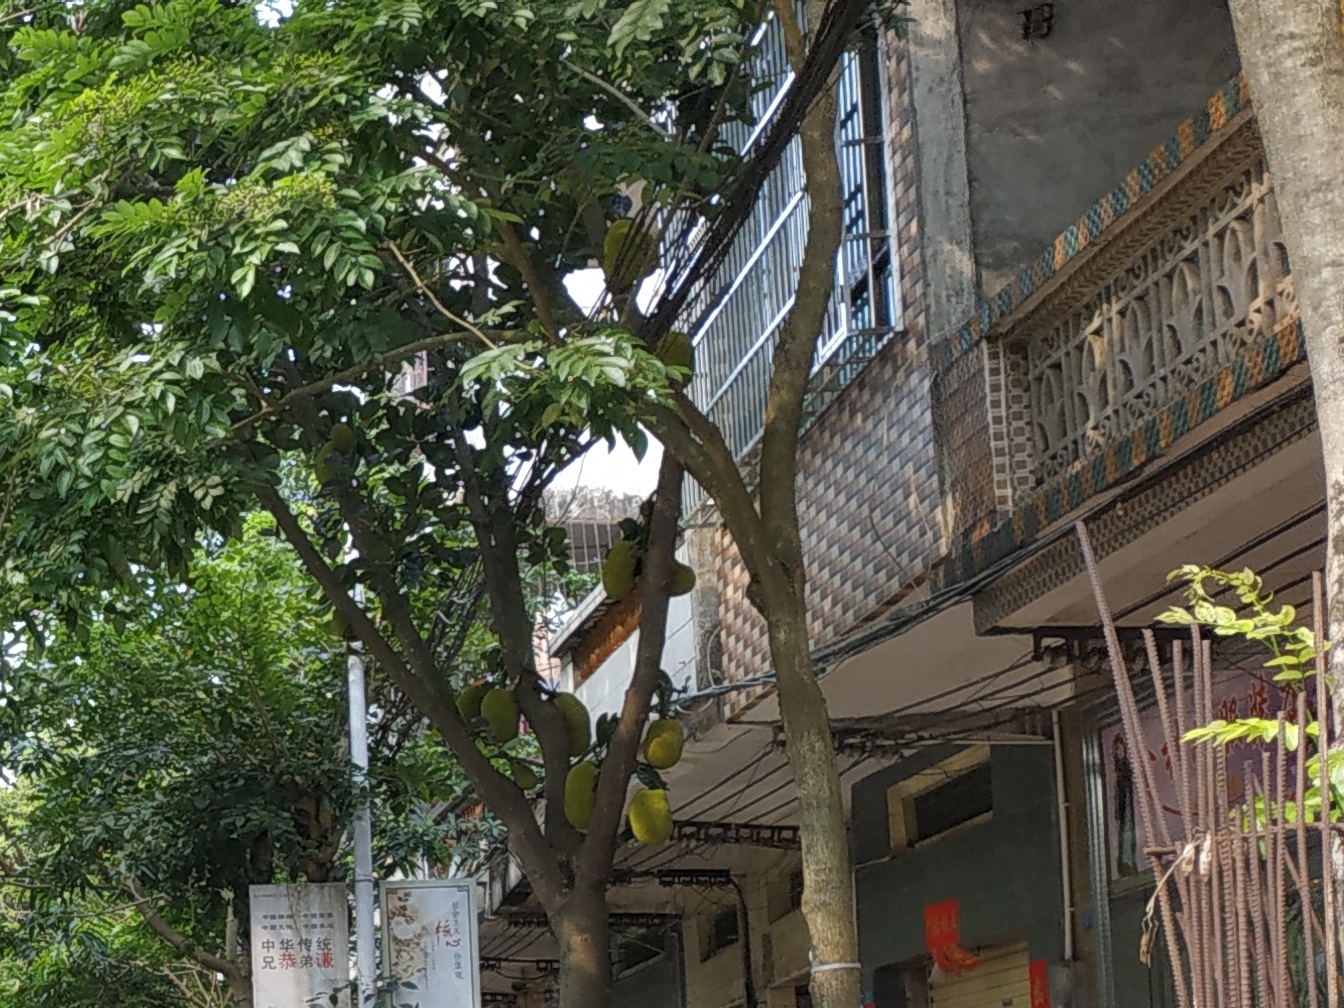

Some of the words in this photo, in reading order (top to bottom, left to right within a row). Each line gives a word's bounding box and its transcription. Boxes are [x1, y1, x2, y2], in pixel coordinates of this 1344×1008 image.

[261, 937, 332, 954] 中华传统
[261, 952, 334, 970] 兄恭弟谦
